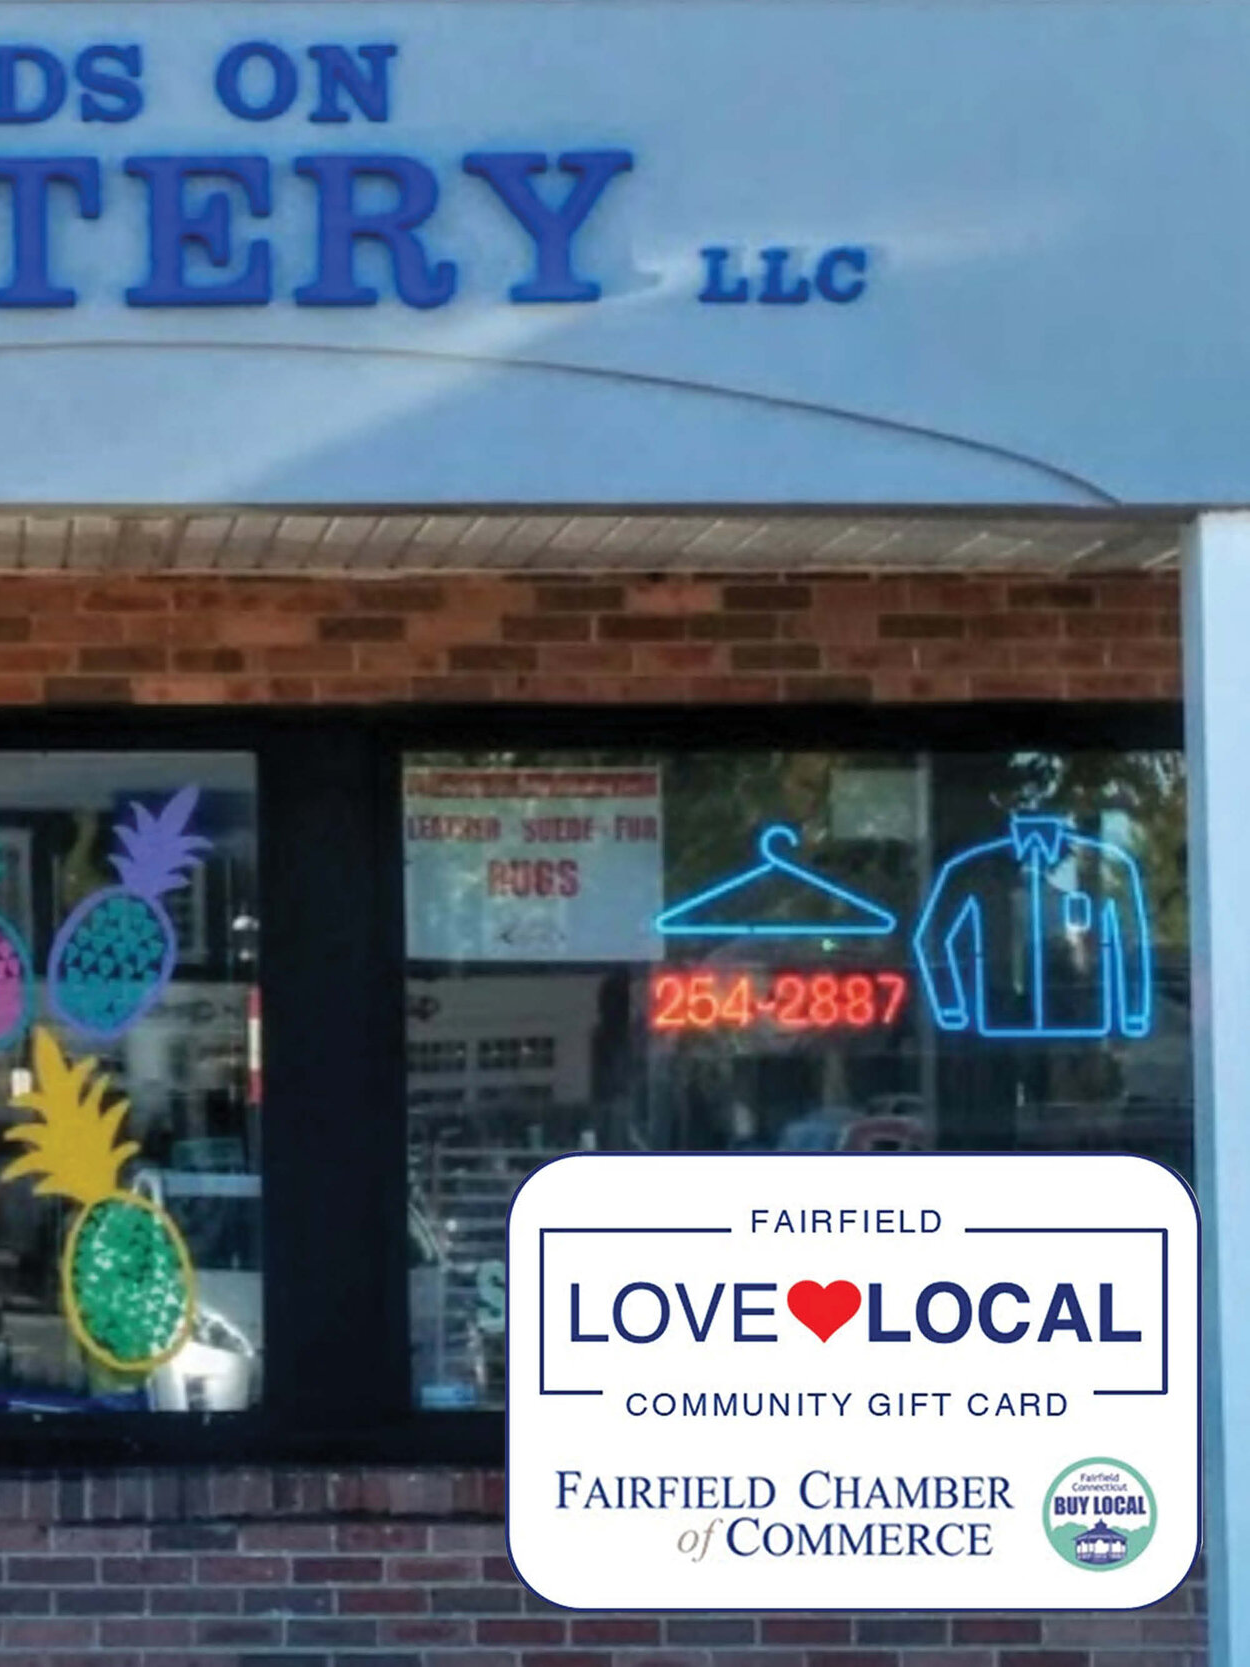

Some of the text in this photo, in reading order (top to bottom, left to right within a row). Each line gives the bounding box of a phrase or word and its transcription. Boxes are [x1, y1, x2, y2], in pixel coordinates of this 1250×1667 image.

[213, 41, 399, 125] ON
[698, 245, 869, 305] LLC
[614, 815, 657, 842] FUR
[487, 858, 579, 898] RUGS
[652, 972, 907, 1032] 254-2887
